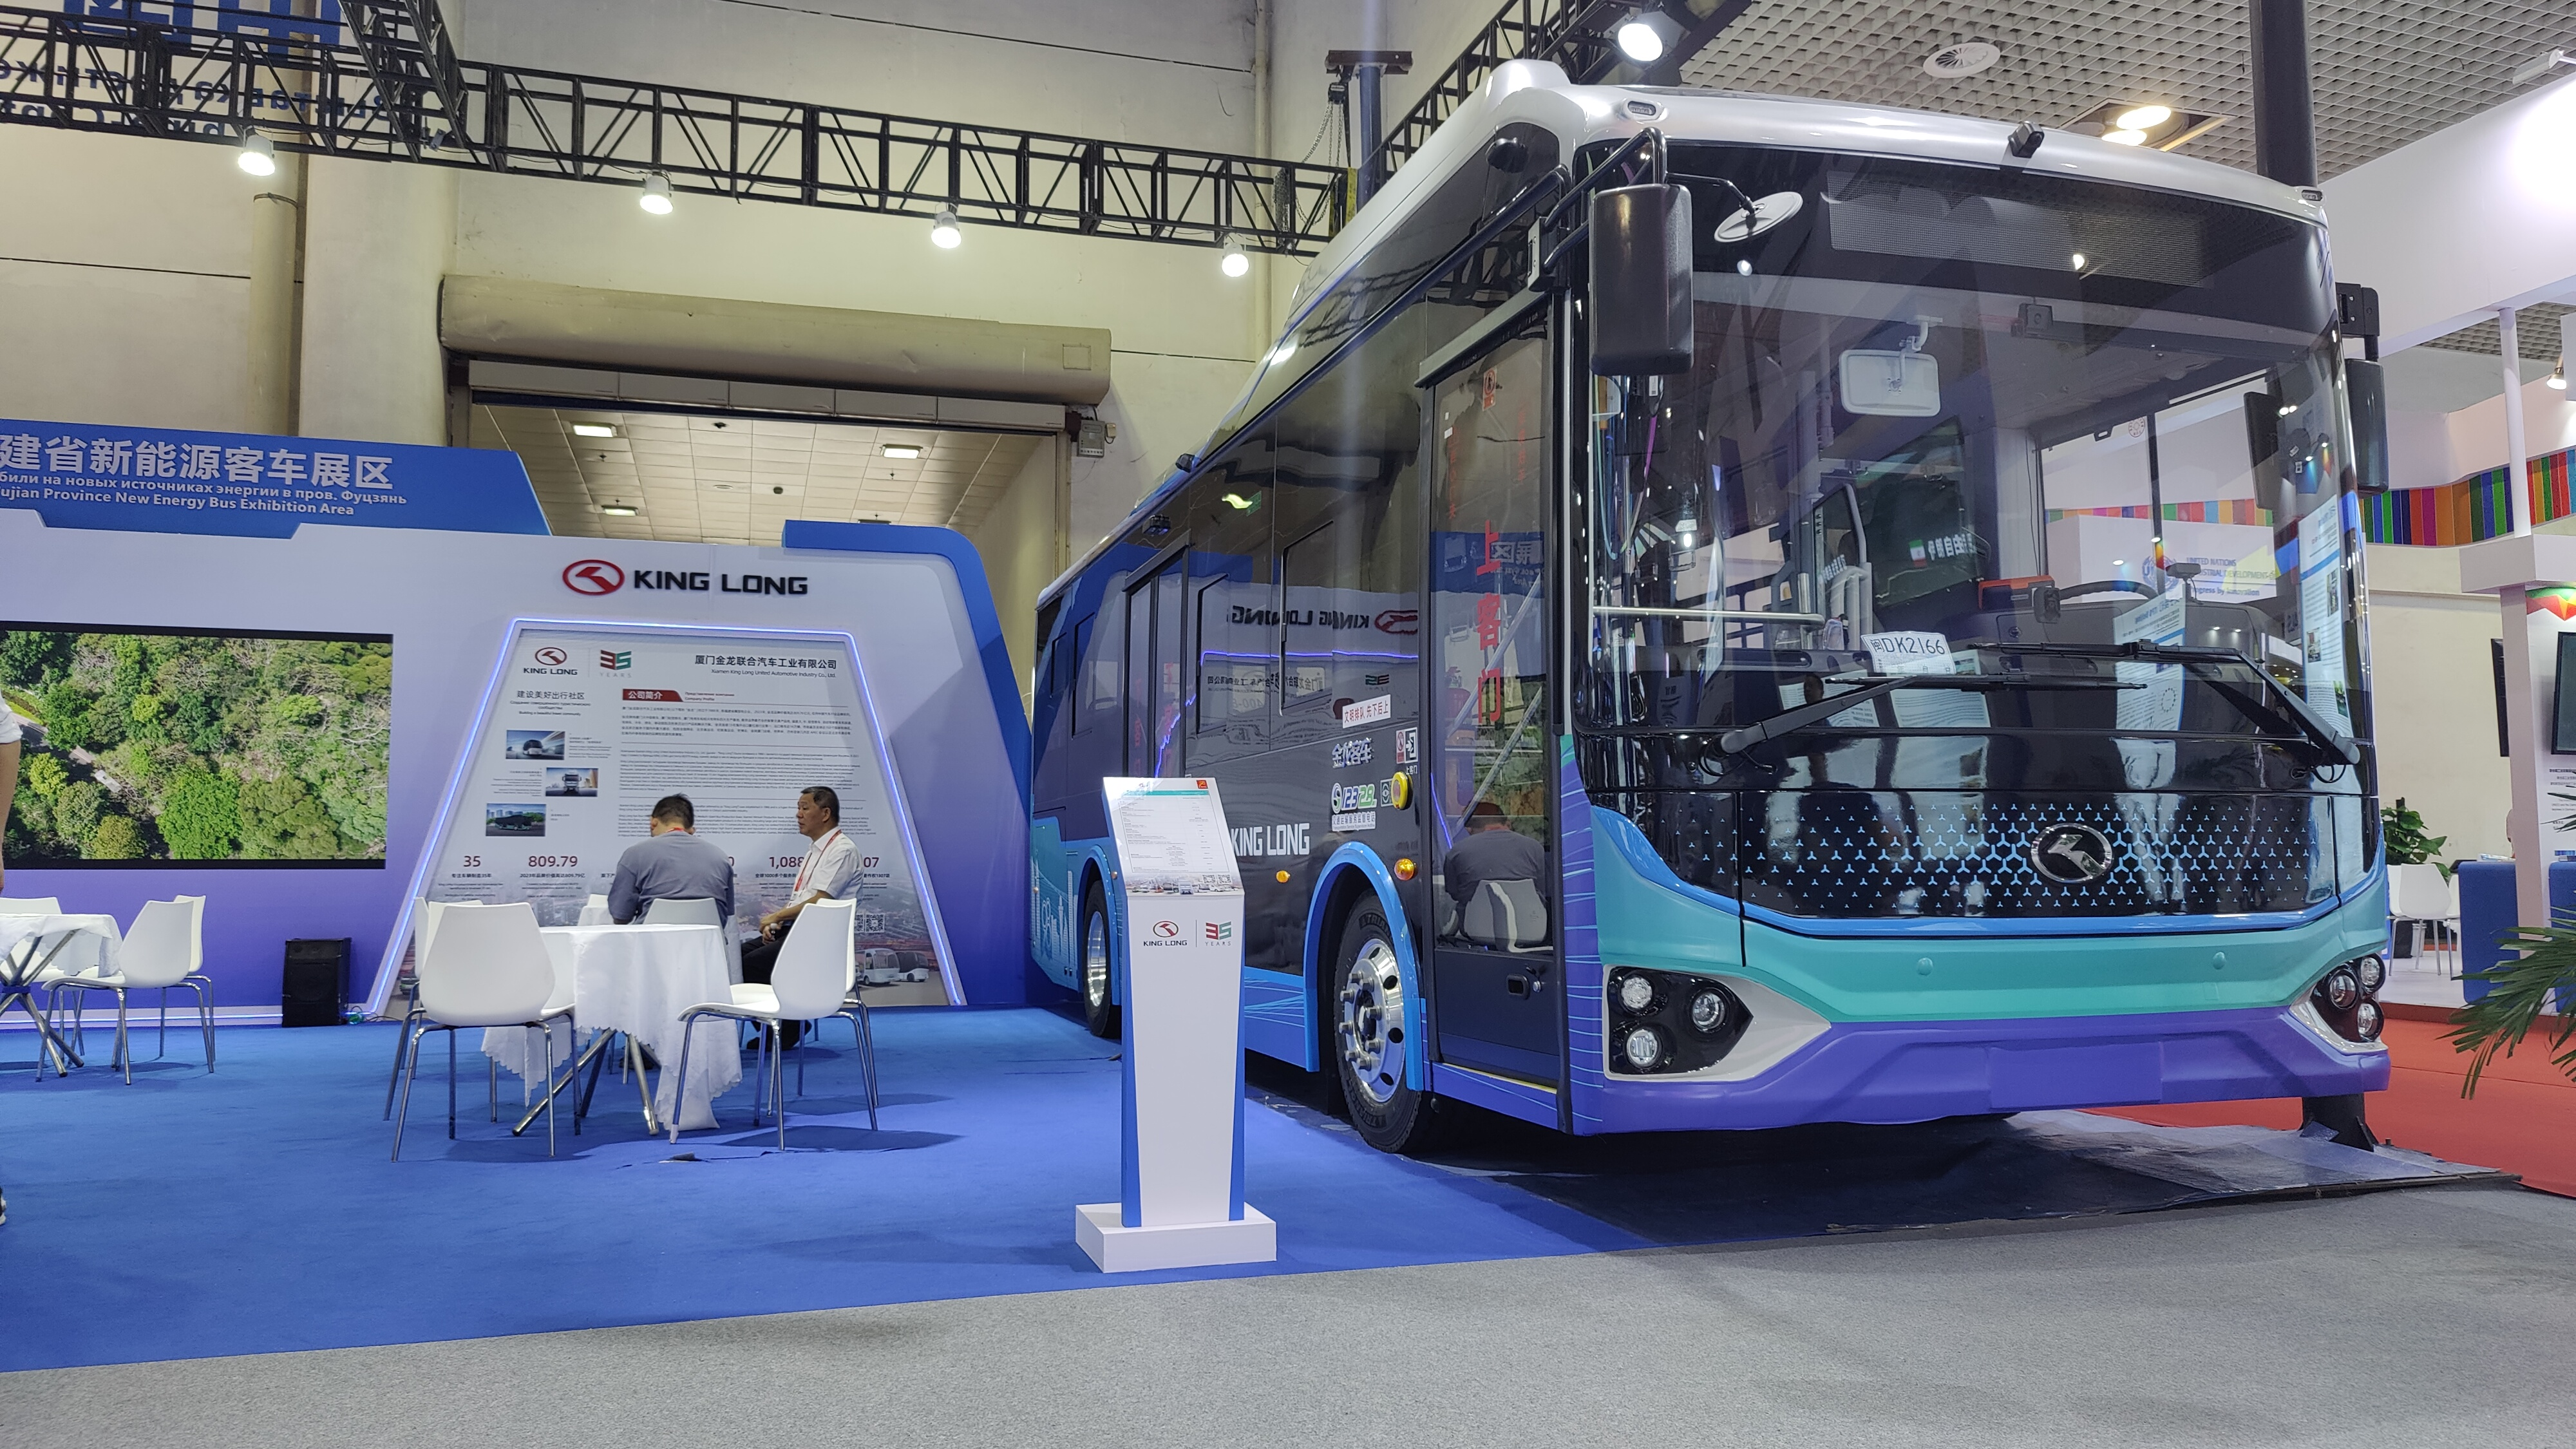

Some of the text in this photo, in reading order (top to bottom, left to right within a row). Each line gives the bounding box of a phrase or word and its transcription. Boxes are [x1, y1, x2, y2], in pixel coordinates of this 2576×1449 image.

[43, 476, 61, 485] на
[66, 477, 117, 488] новых
[121, 480, 213, 493] источниках
[216, 486, 279, 498] энергии
[296, 490, 338, 502] пров.
[341, 491, 407, 505] Фуцзянь
[0, 486, 354, 515] ujian Province New Energy Bus Exhibition Area
[634, 569, 808, 596] KING LONG
[1476, 519, 1502, 724] 上客门
[1870, 637, 1945, 654] 闽DK2166
[600, 650, 632, 670] 35
[695, 655, 837, 669] 厦门金龙联合汽车工业有限公司
[516, 690, 585, 699] 建设美好出行社区
[628, 691, 663, 700] 公司简介
[1344, 699, 1389, 723] 文明排队 先下后上
[1231, 823, 1310, 856] KING LONG
[463, 856, 481, 867] 35
[528, 856, 578, 867] 809.79
[1206, 921, 1231, 940] 35
